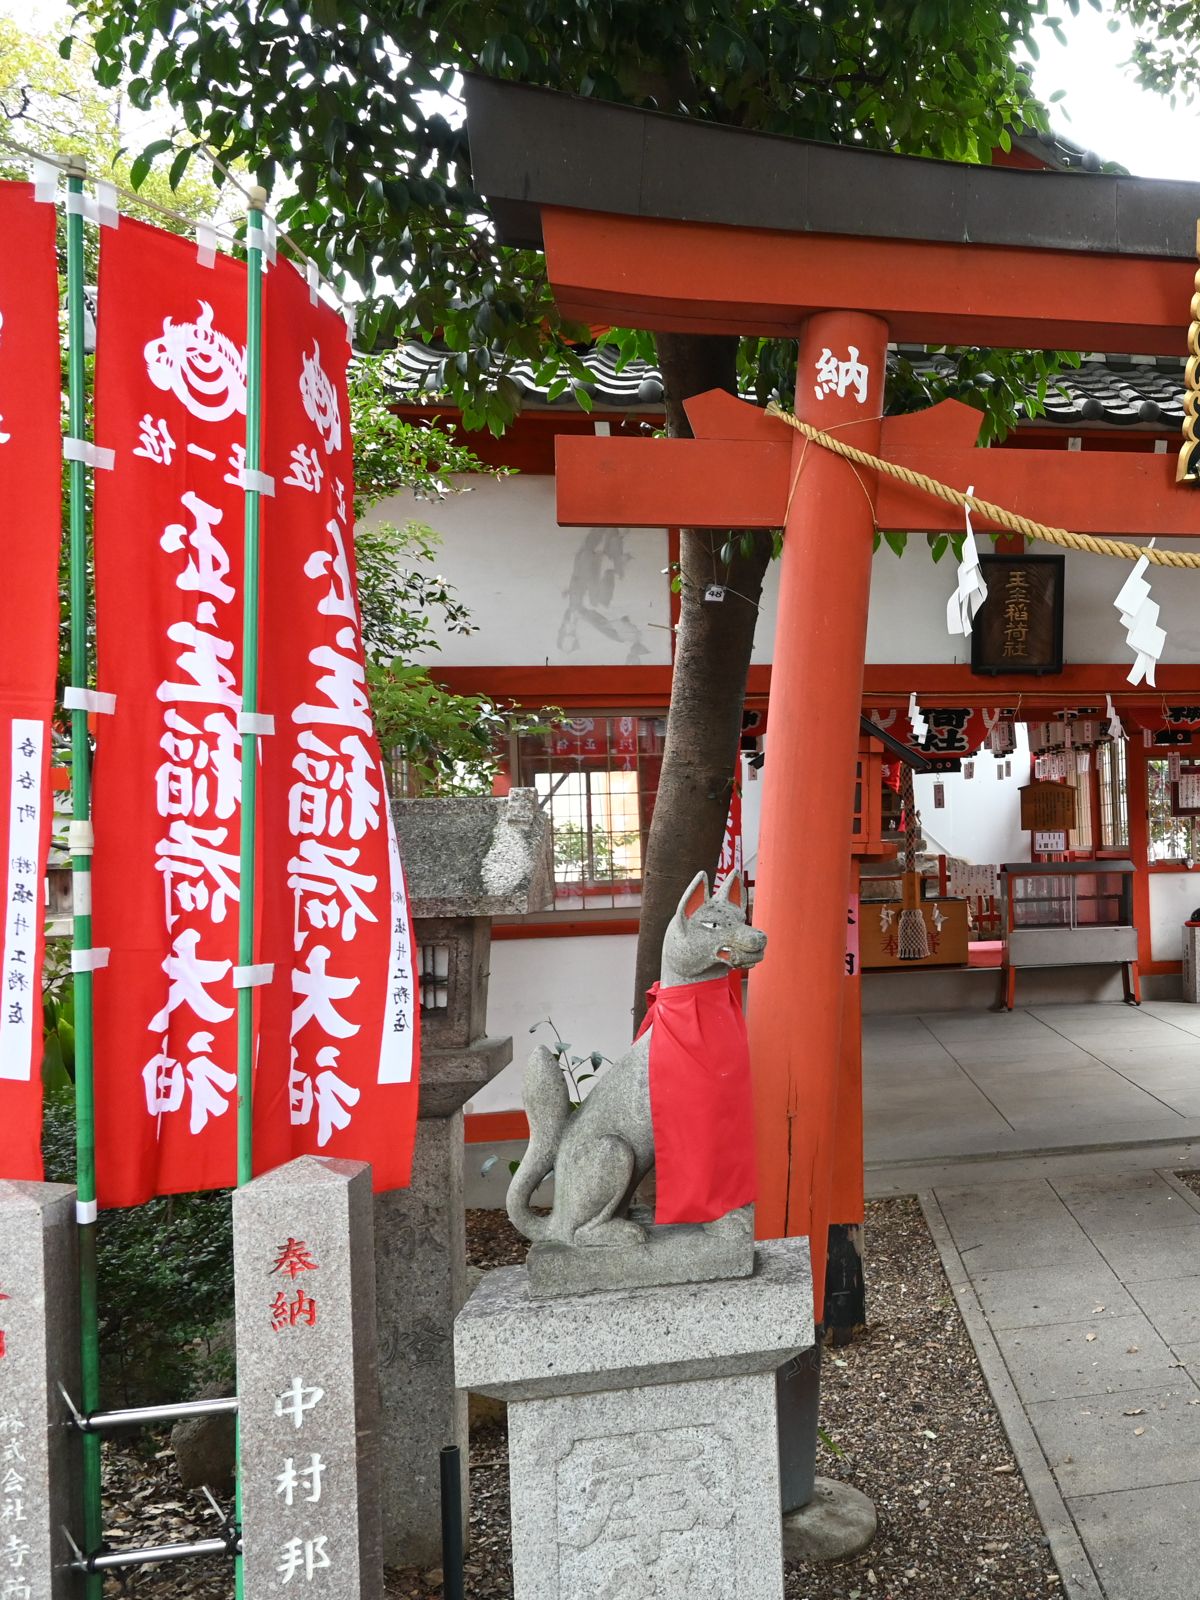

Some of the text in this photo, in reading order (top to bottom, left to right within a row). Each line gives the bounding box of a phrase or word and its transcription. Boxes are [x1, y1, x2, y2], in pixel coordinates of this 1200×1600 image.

[814, 345, 869, 404] 納
[268, 1237, 320, 1333] 奉納
[273, 1376, 332, 1586] 中村邦
